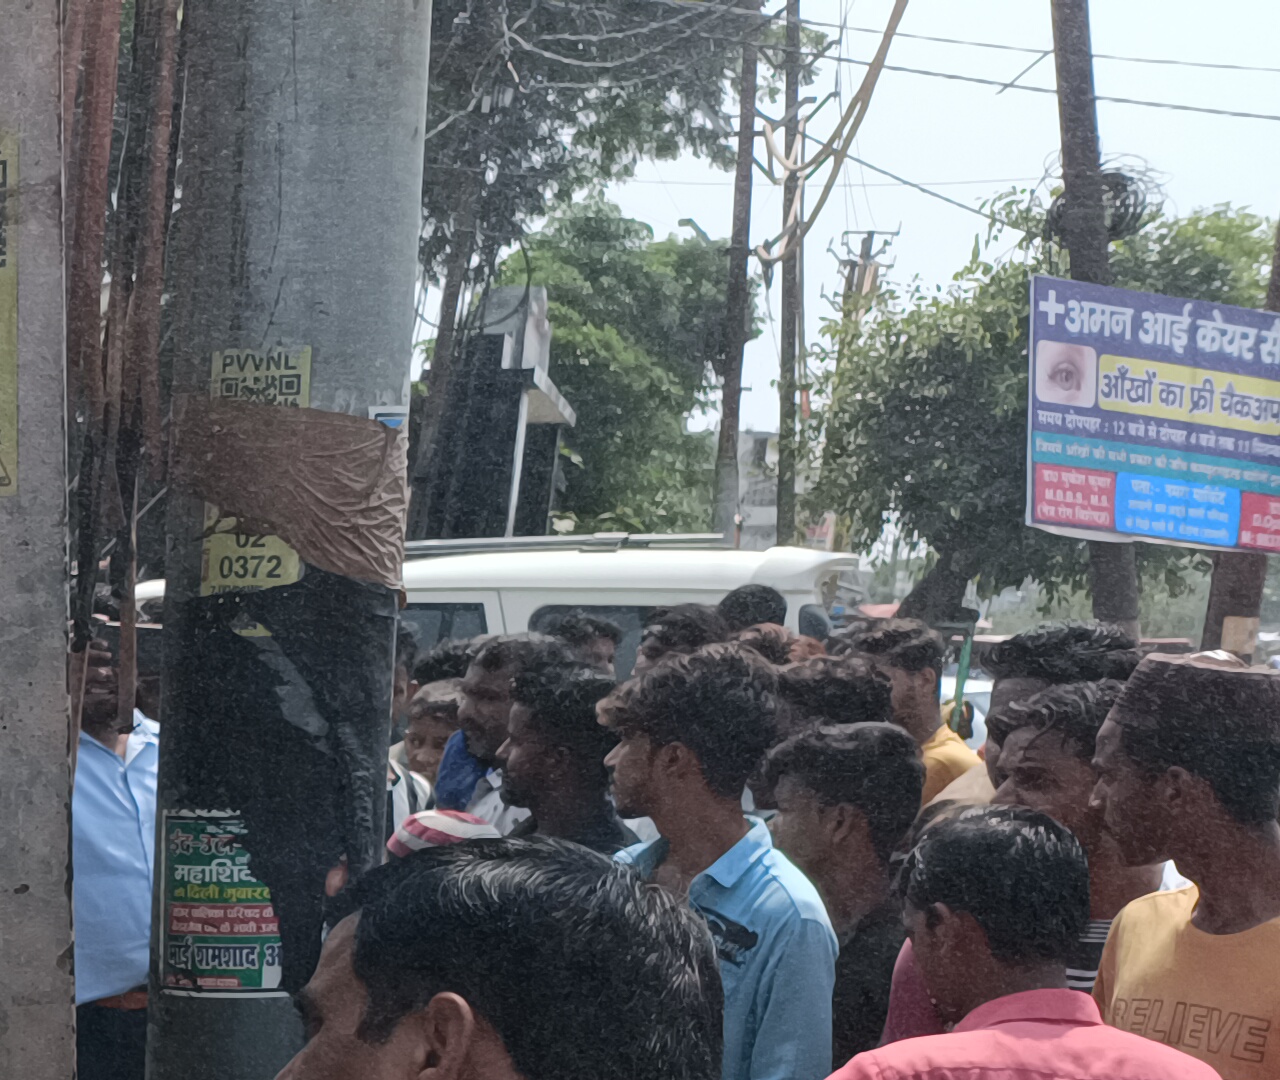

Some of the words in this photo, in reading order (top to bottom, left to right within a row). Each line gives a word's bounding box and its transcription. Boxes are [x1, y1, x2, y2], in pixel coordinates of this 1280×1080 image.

[1064, 299, 1134, 340] अमन
[1139, 303, 1194, 353] आई
[1196, 309, 1259, 360] केयर
[222, 351, 298, 373] PVVNL
[1158, 381, 1185, 409] का
[1188, 378, 1214, 415] फ्री
[220, 555, 282, 579] 0372
[194, 944, 260, 970] शमशाद
